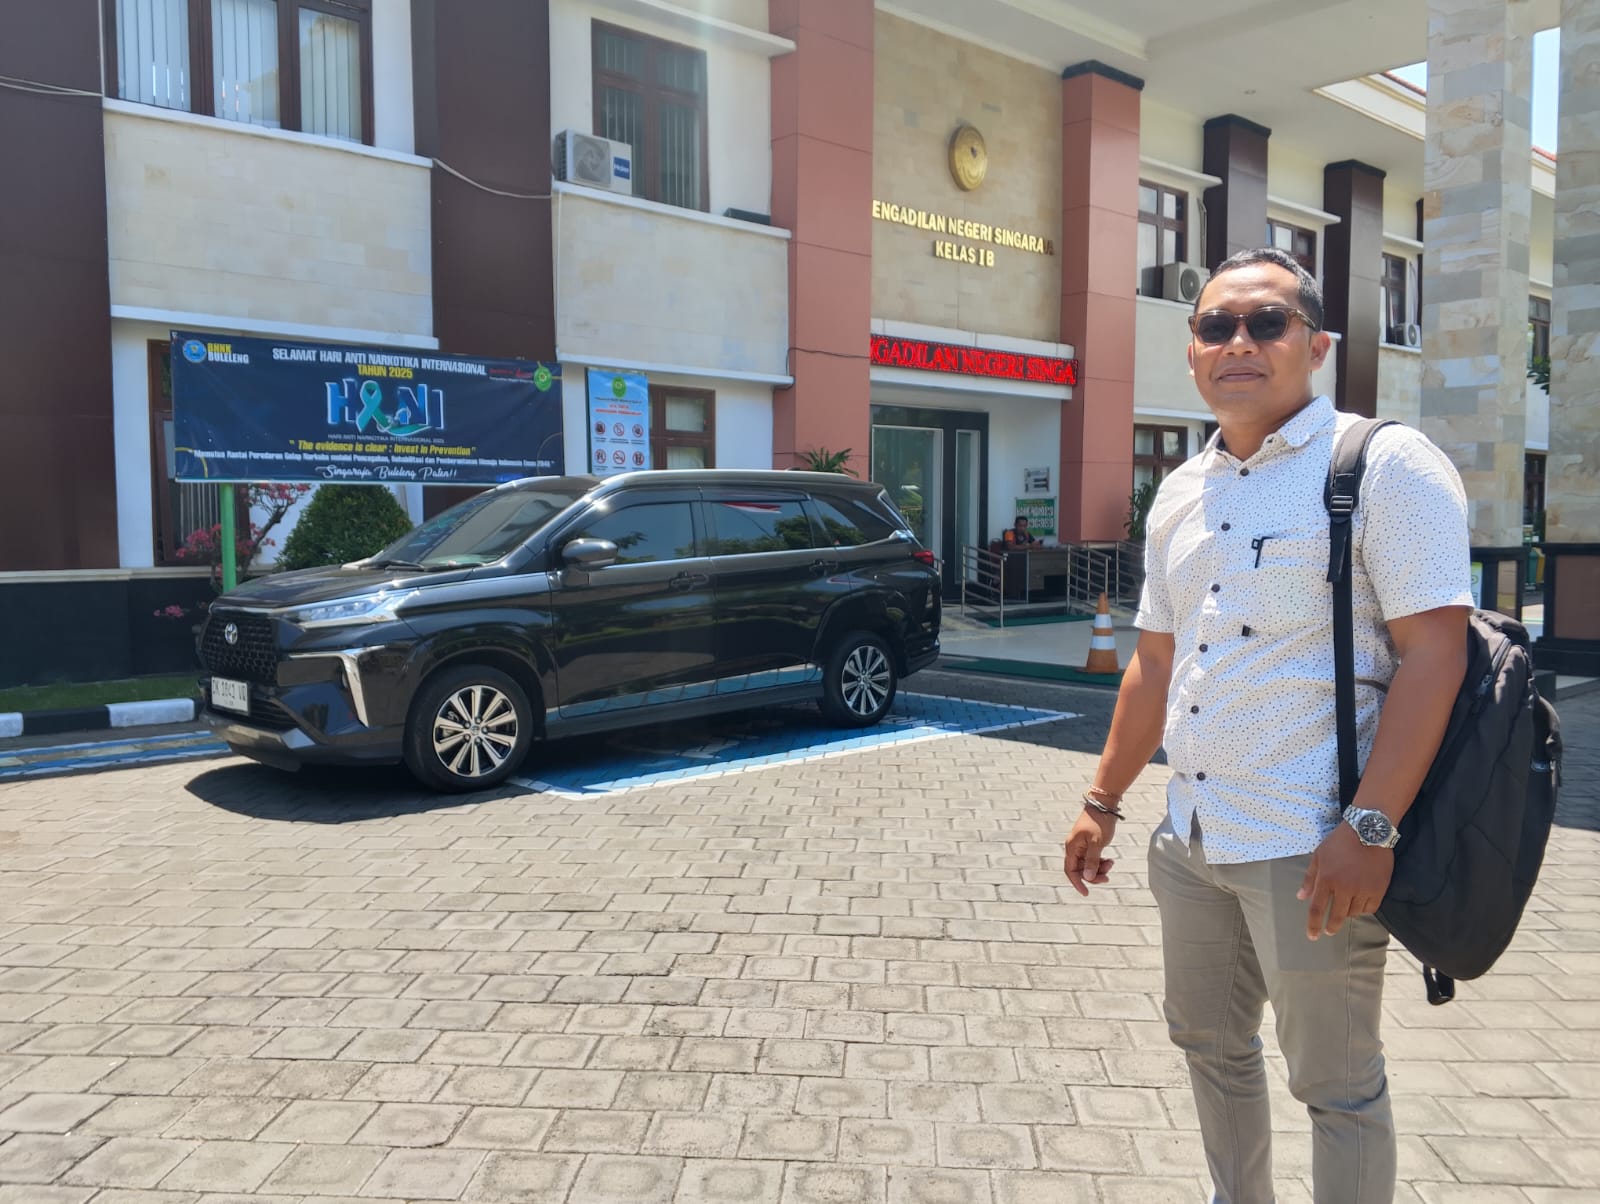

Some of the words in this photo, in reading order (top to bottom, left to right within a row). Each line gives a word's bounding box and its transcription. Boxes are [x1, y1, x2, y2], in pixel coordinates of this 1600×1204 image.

[948, 217, 993, 242] NEGERI
[935, 239, 976, 265] KELAS
[208, 351, 249, 365] BULELENG
[272, 347, 317, 362] SELAMAT
[319, 350, 342, 363] HARI
[344, 351, 367, 364] ANTI
[368, 353, 419, 369] NARKOTIKA
[421, 358, 488, 376] INTERNASIONAL
[961, 349, 1024, 379] NEGERI
[357, 364, 387, 377] TAHUN
[298, 439, 314, 450] The
[314, 441, 353, 452] evidence
[355, 442, 364, 453] is
[365, 443, 387, 453] clear
[315, 464, 373, 479] Singaraja
[373, 465, 417, 480] Buleleng
